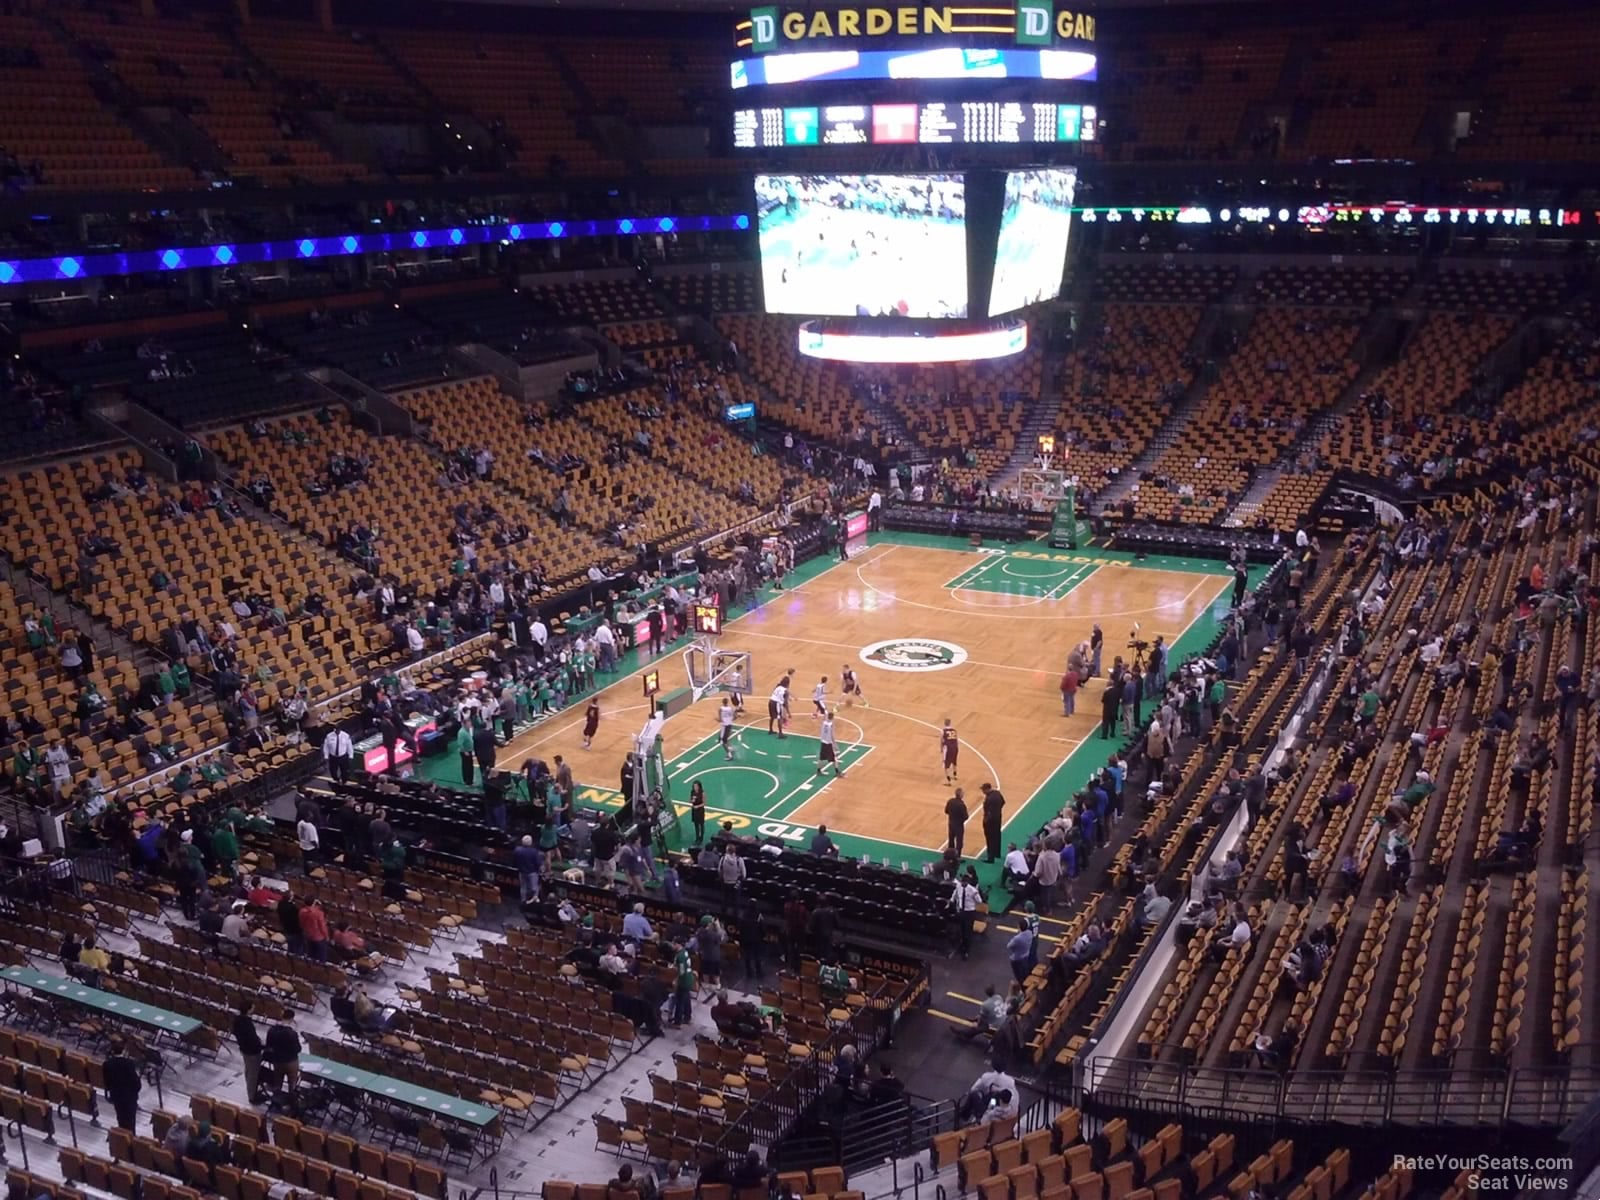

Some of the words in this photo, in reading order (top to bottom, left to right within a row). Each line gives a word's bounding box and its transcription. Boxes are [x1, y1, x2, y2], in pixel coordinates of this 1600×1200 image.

[752, 15, 775, 43] TD
[783, 7, 951, 40] GARDEN
[1021, 7, 1049, 36] TD
[1012, 551, 1132, 567] GARDEN
[757, 822, 807, 841] TD
[864, 956, 919, 976] GARDEN
